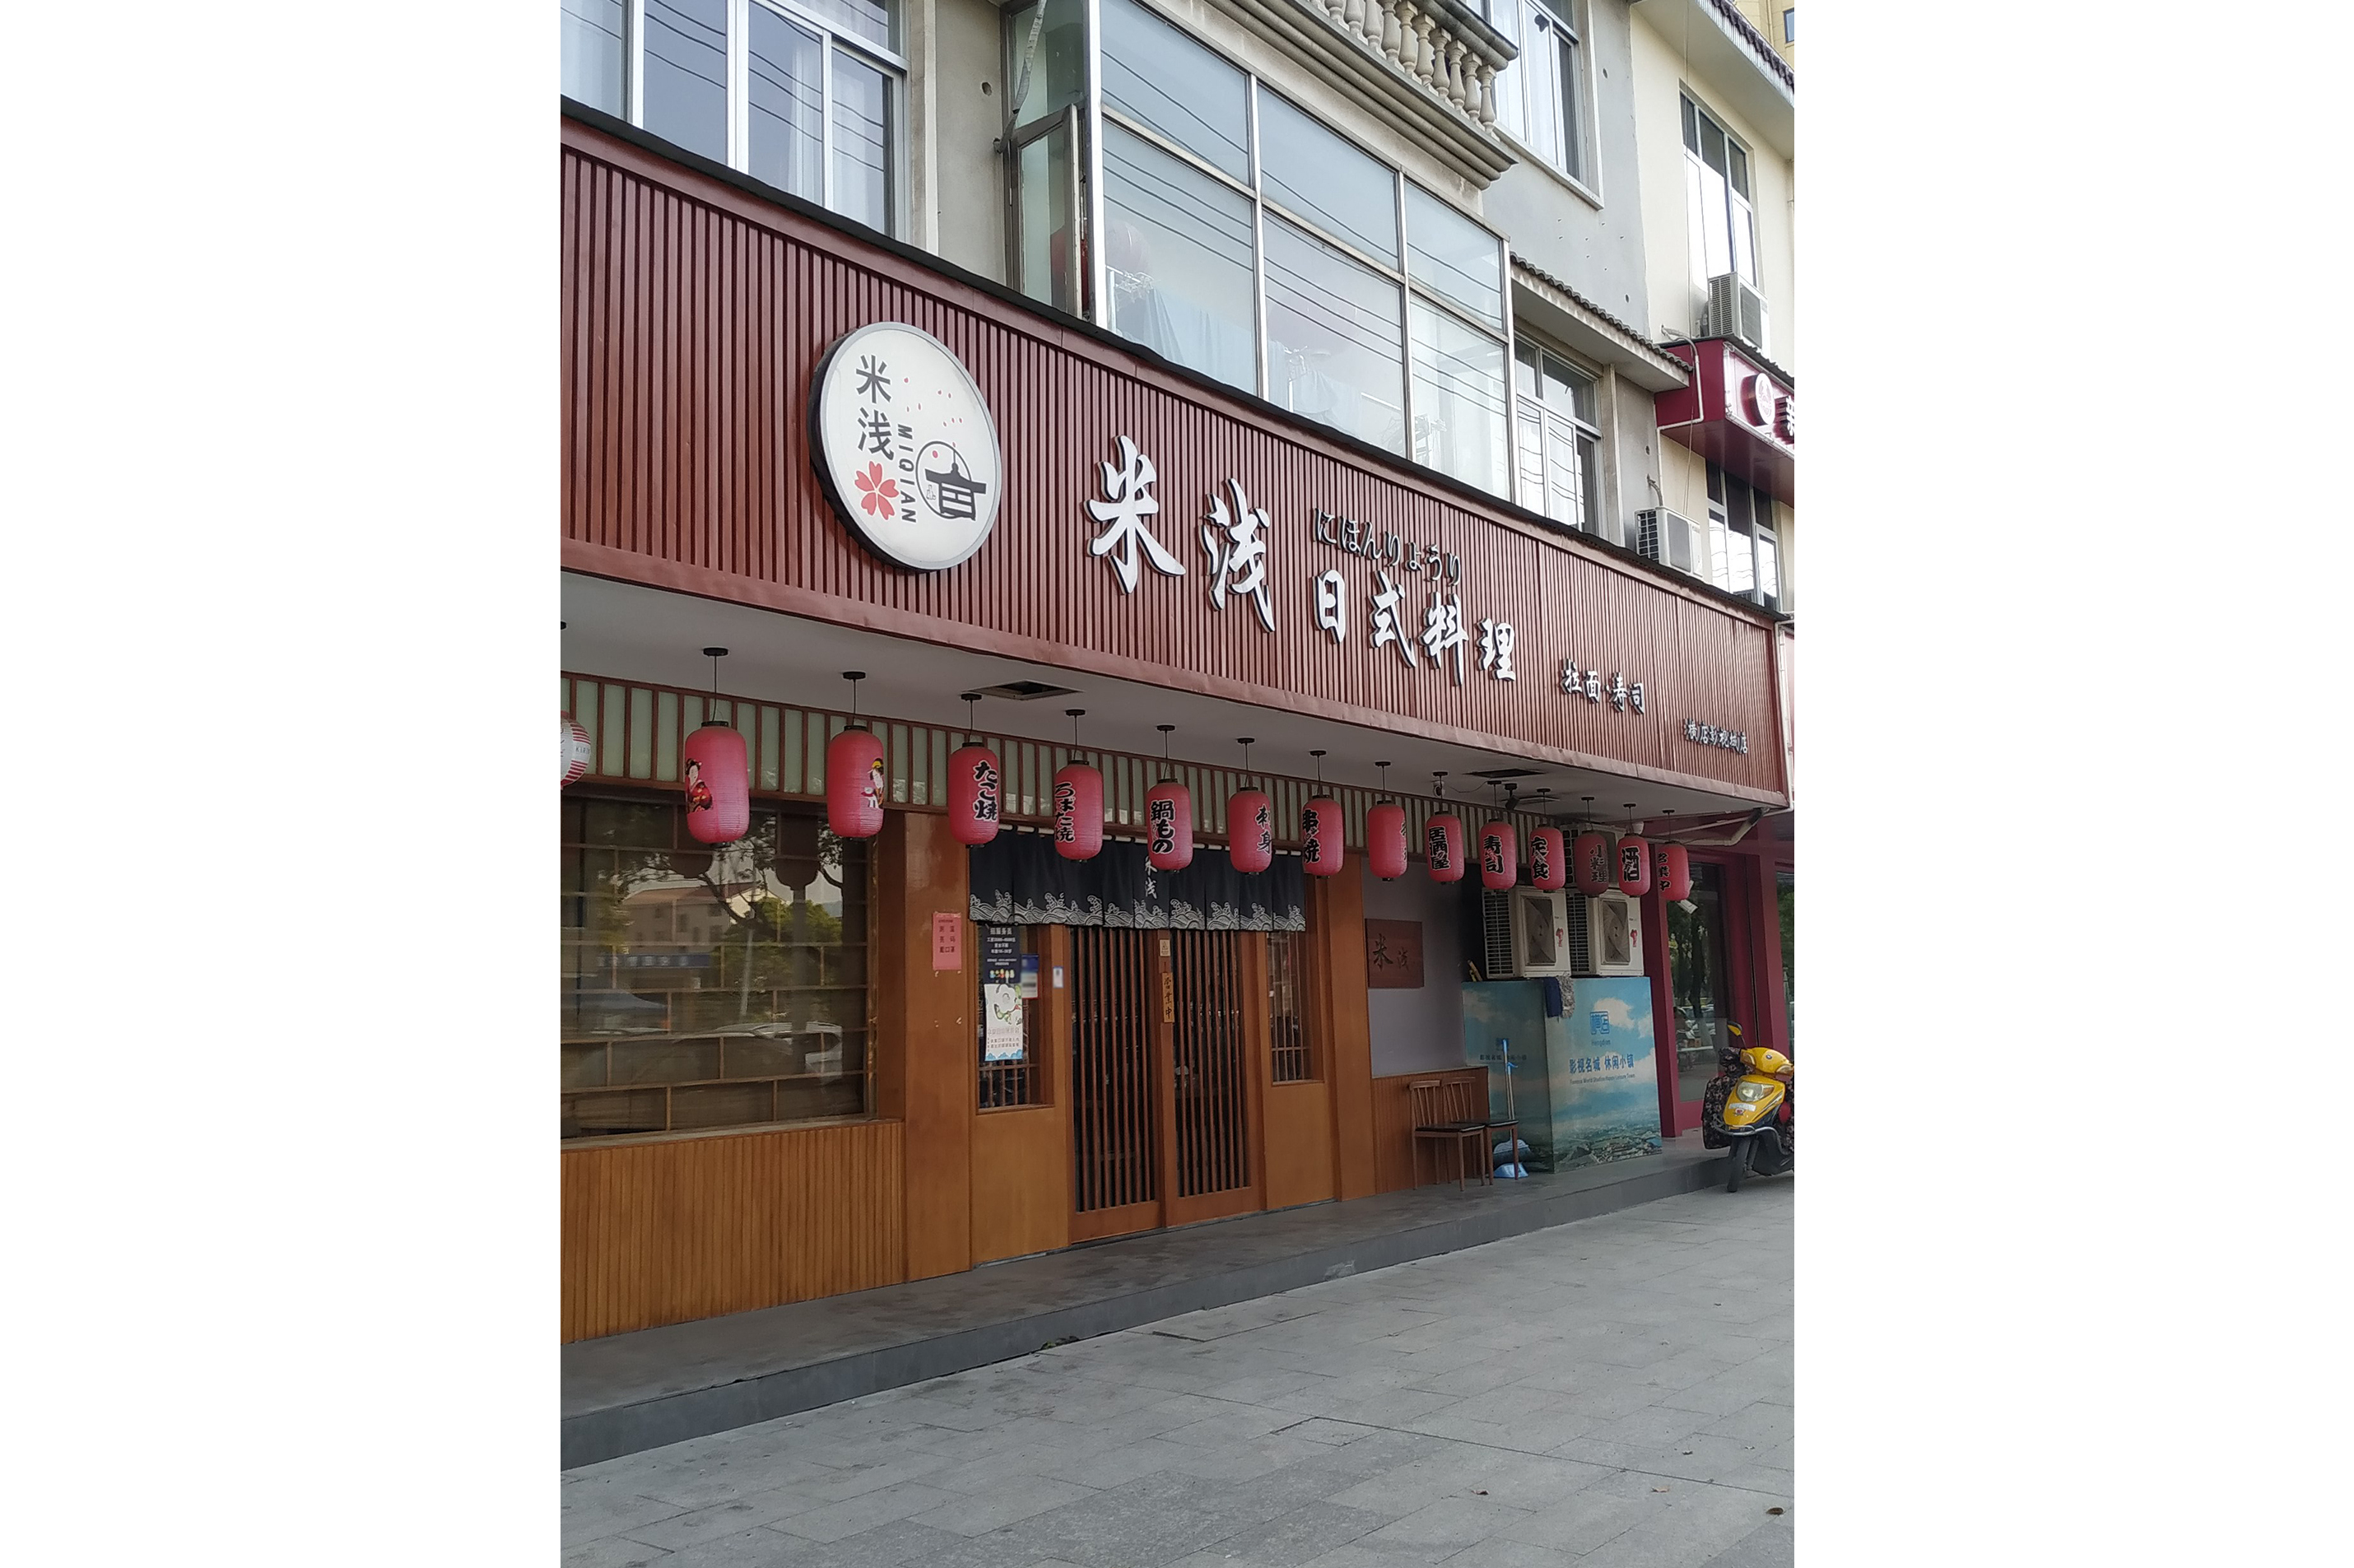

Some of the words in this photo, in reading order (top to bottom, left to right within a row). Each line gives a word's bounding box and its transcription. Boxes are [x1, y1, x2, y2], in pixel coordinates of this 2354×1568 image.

[855, 354, 895, 461] 米浅
[897, 423, 917, 523] MIQIAN
[1083, 435, 1277, 633] 米浅
[1311, 568, 1516, 686] 日式料理
[972, 759, 999, 824] たこ焼
[1150, 798, 1176, 854] 鍋もの
[1427, 825, 1451, 871] 居酒屋
[1482, 834, 1505, 875] 寿司
[1530, 835, 1551, 881] 定食
[1569, 1056, 1601, 1074] 影视名城
[1604, 1054, 1635, 1071] 休闲小镇
